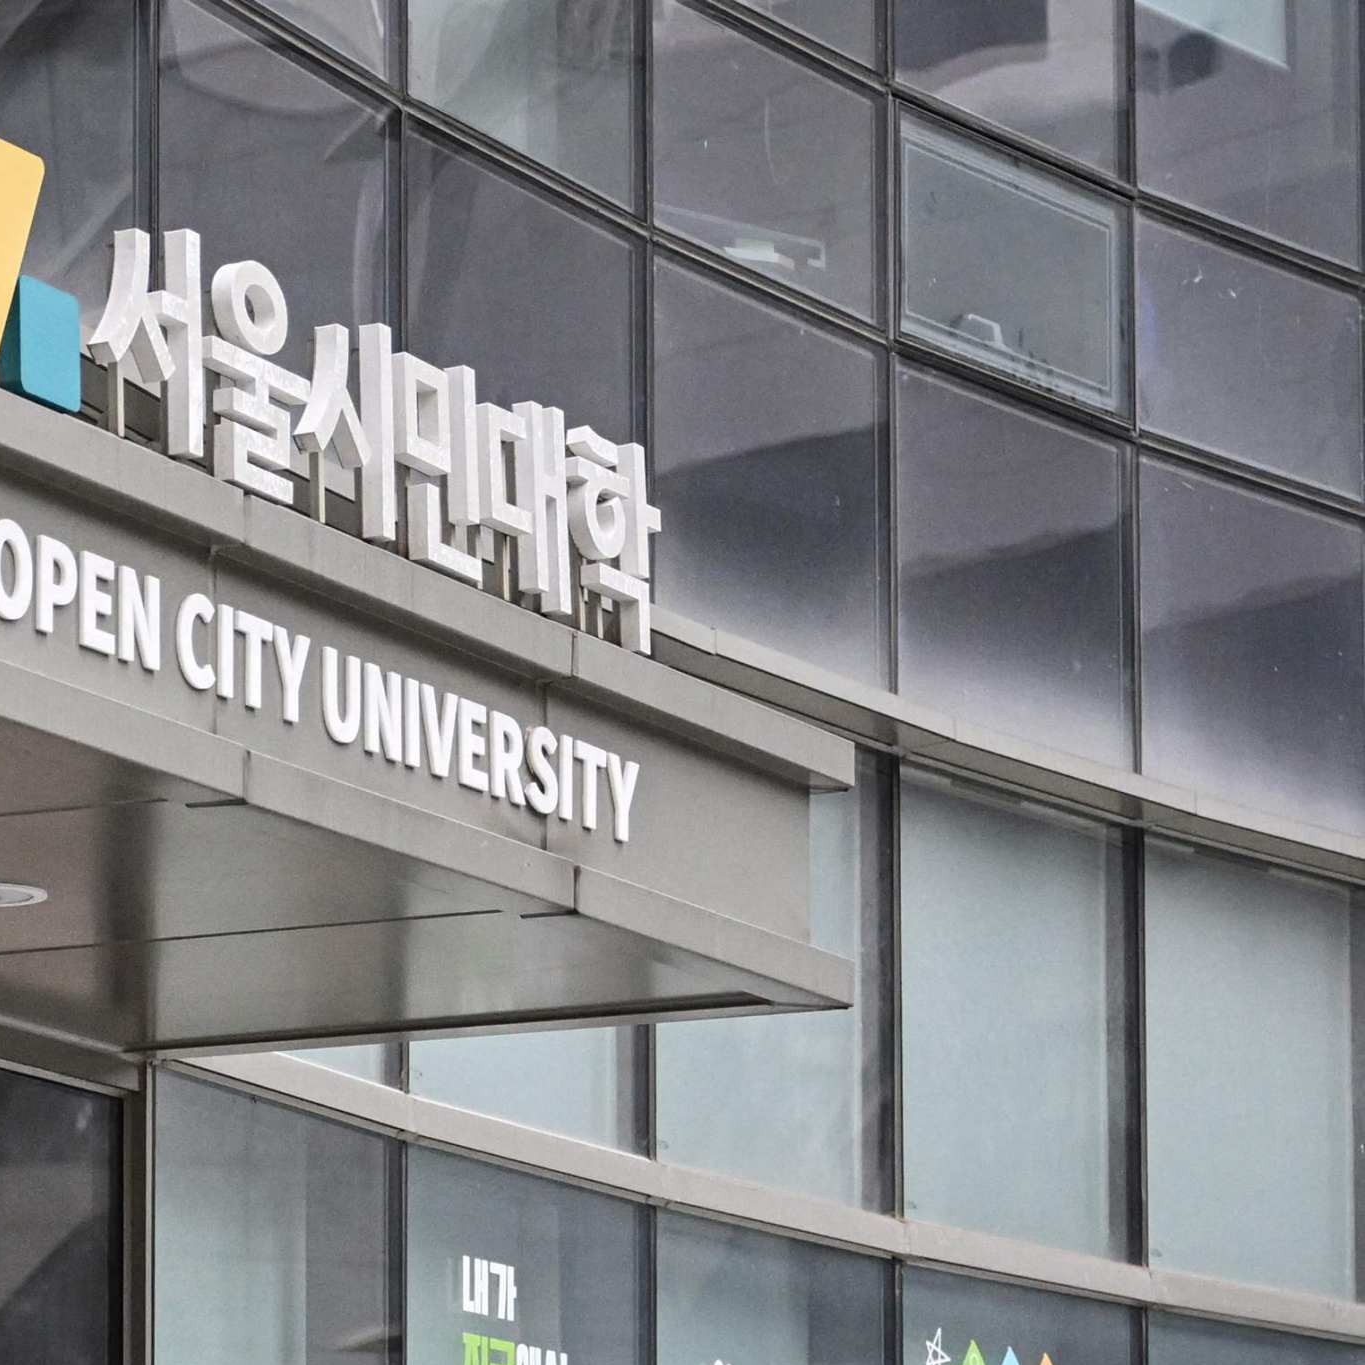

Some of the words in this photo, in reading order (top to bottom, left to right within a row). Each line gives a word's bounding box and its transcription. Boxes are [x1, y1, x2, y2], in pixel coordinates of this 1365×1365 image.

[86, 227, 661, 656] 서울시민대학
[174, 591, 311, 726] CITY
[319, 644, 641, 844] UNIVERSITY
[462, 1255, 517, 1322] 내가
